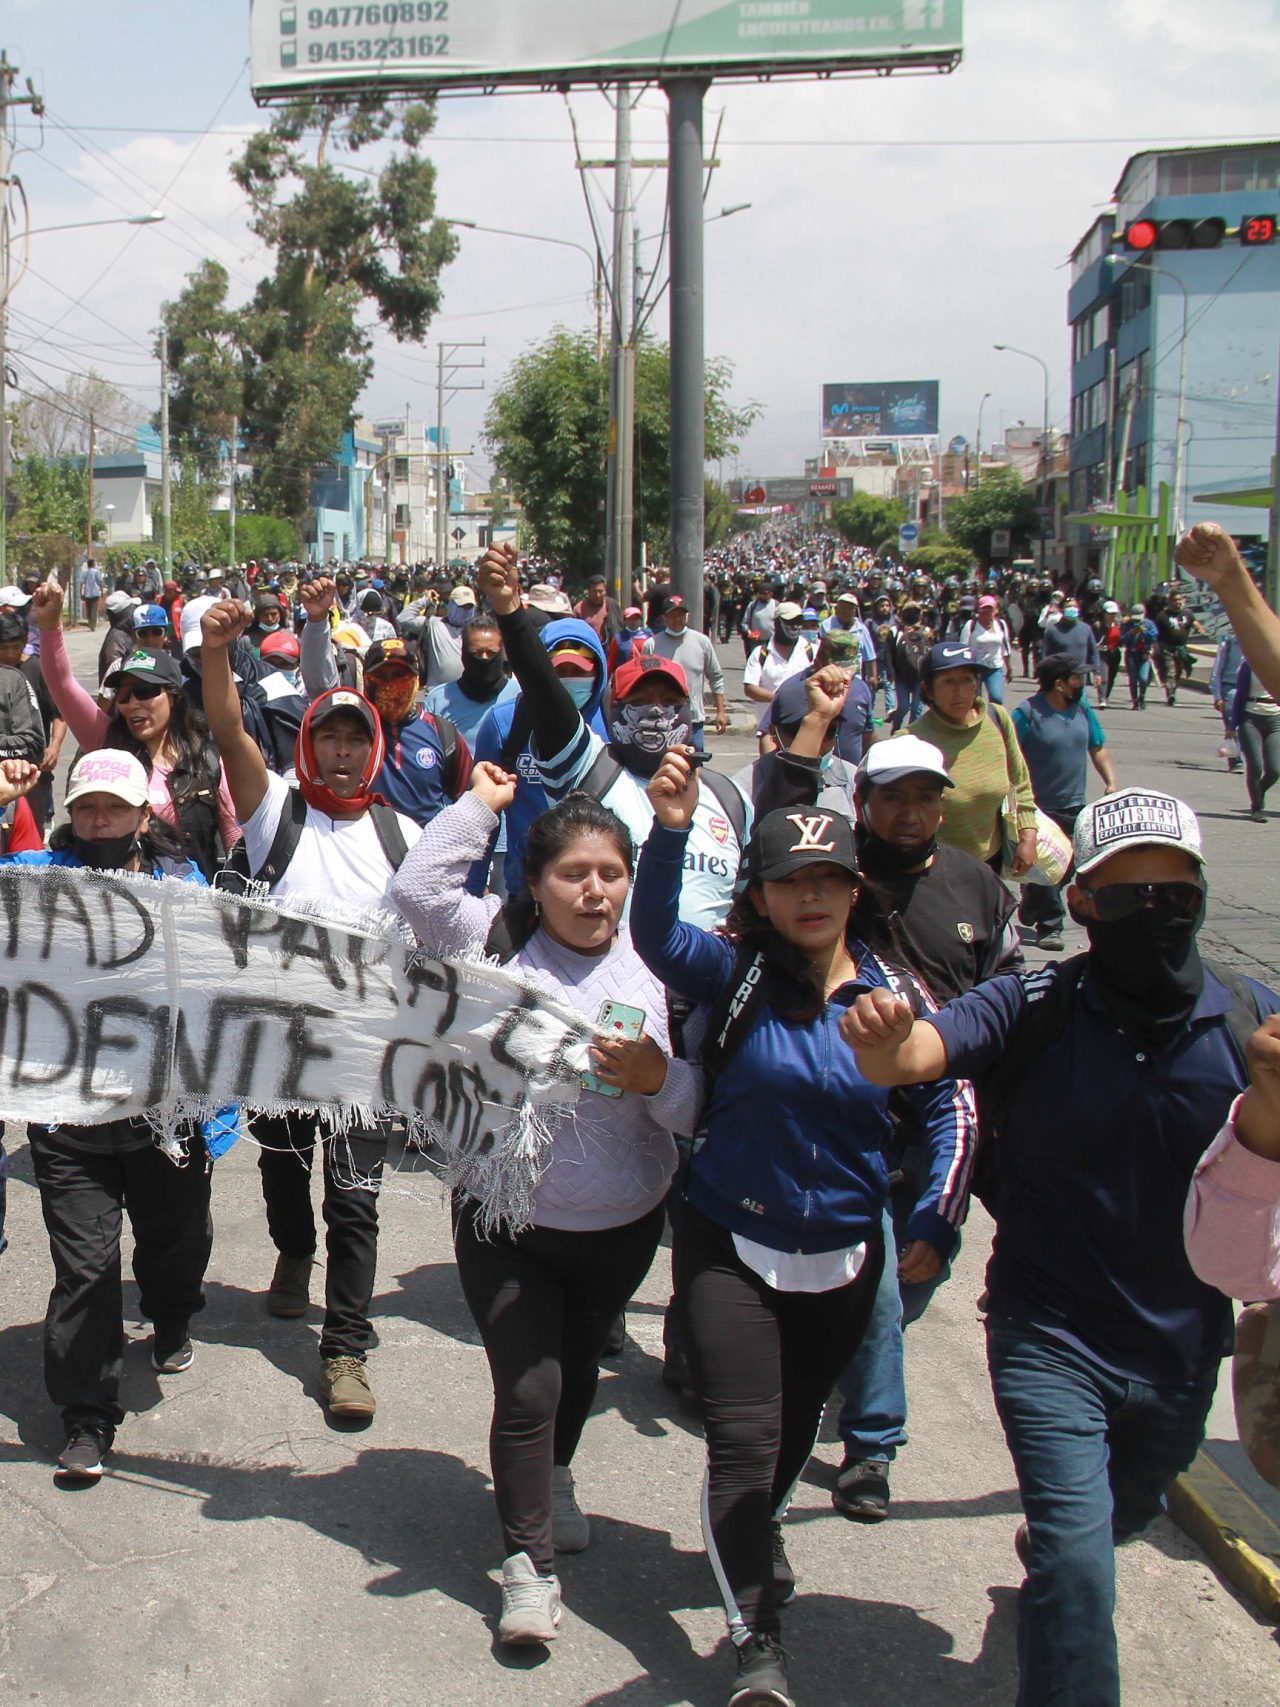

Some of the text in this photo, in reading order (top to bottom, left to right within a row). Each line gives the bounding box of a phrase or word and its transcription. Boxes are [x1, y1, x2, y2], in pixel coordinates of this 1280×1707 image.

[308, 1, 449, 30] 947760892
[308, 34, 449, 63] 945323162
[1247, 219, 1273, 241] 23
[1098, 798, 1172, 816] PARENTAL
[1099, 808, 1174, 830] ADVISORY
[1100, 822, 1176, 839] EXPLICIT CONTENT
